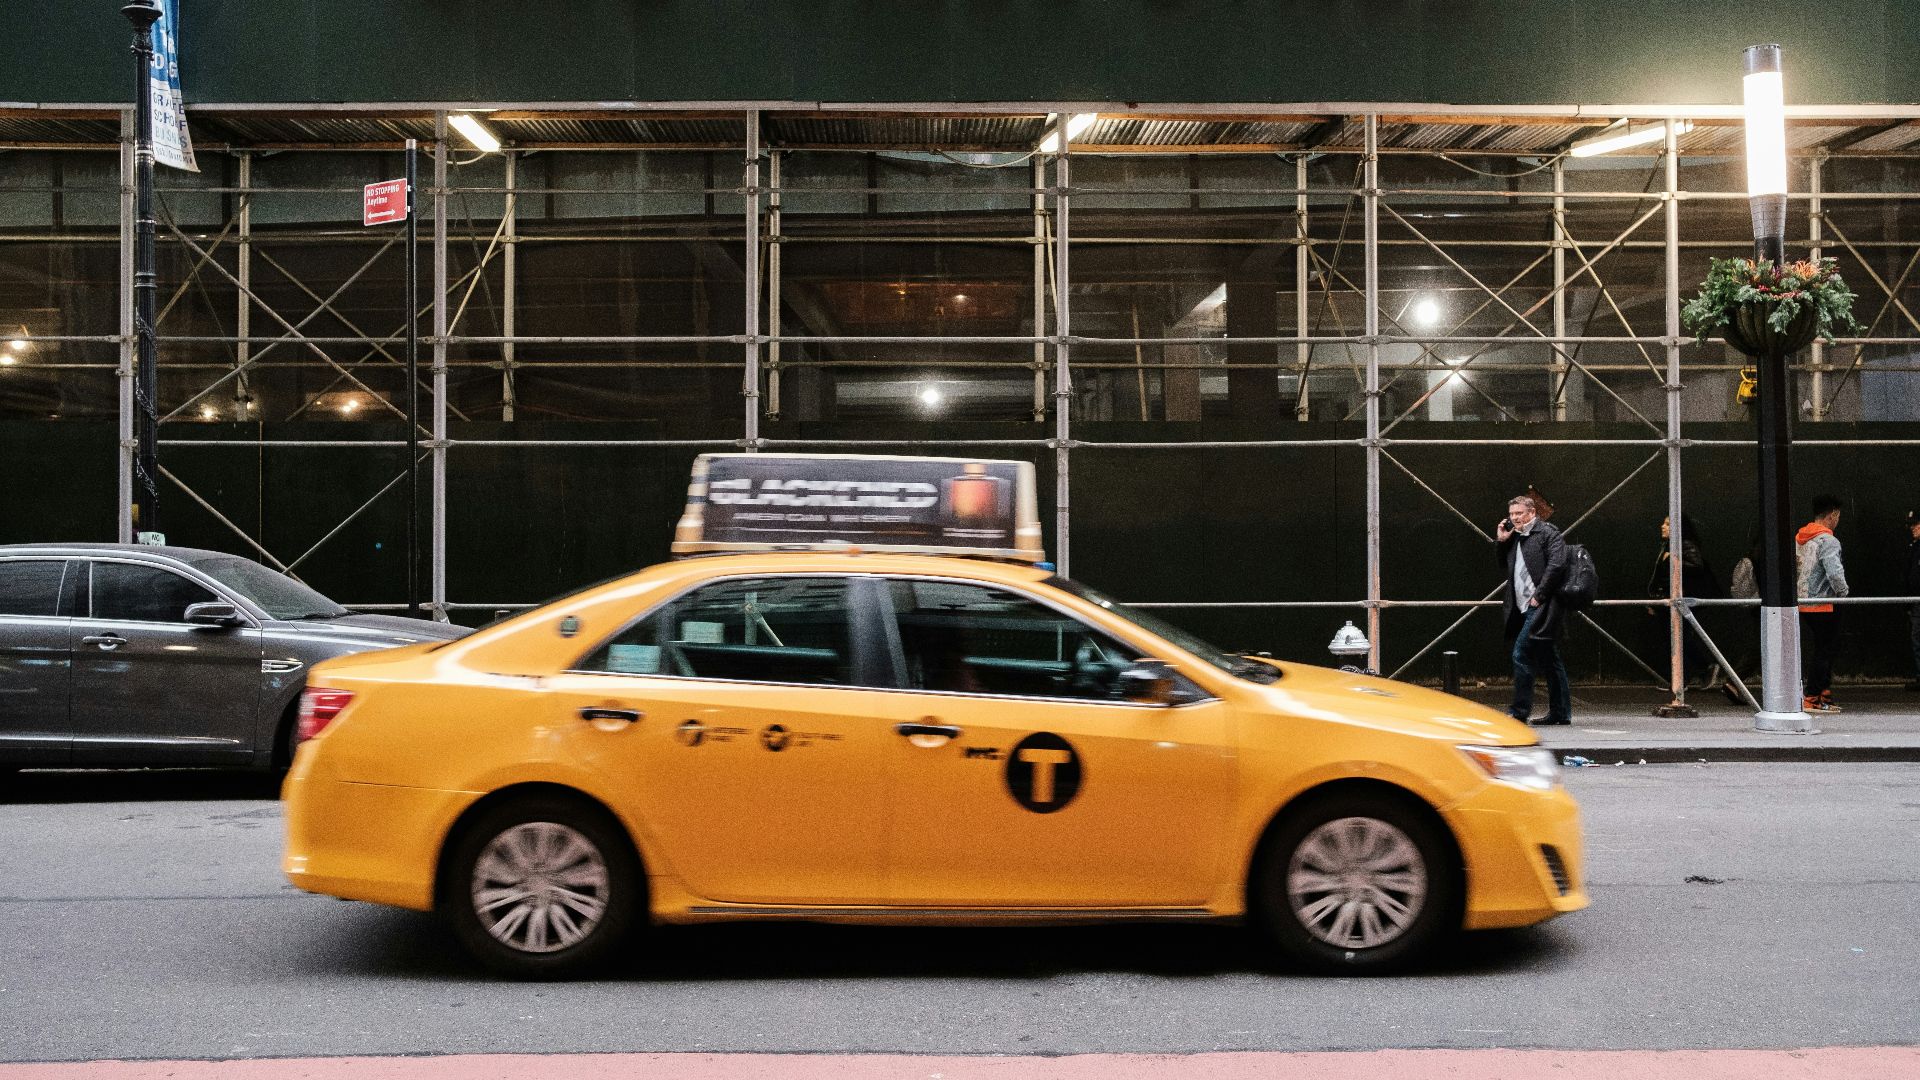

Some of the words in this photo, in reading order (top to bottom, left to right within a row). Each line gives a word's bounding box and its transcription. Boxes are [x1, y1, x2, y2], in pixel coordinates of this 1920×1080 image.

[375, 184, 399, 195] STOPPING
[367, 197, 387, 206] Anytime
[1017, 748, 1072, 803] T
